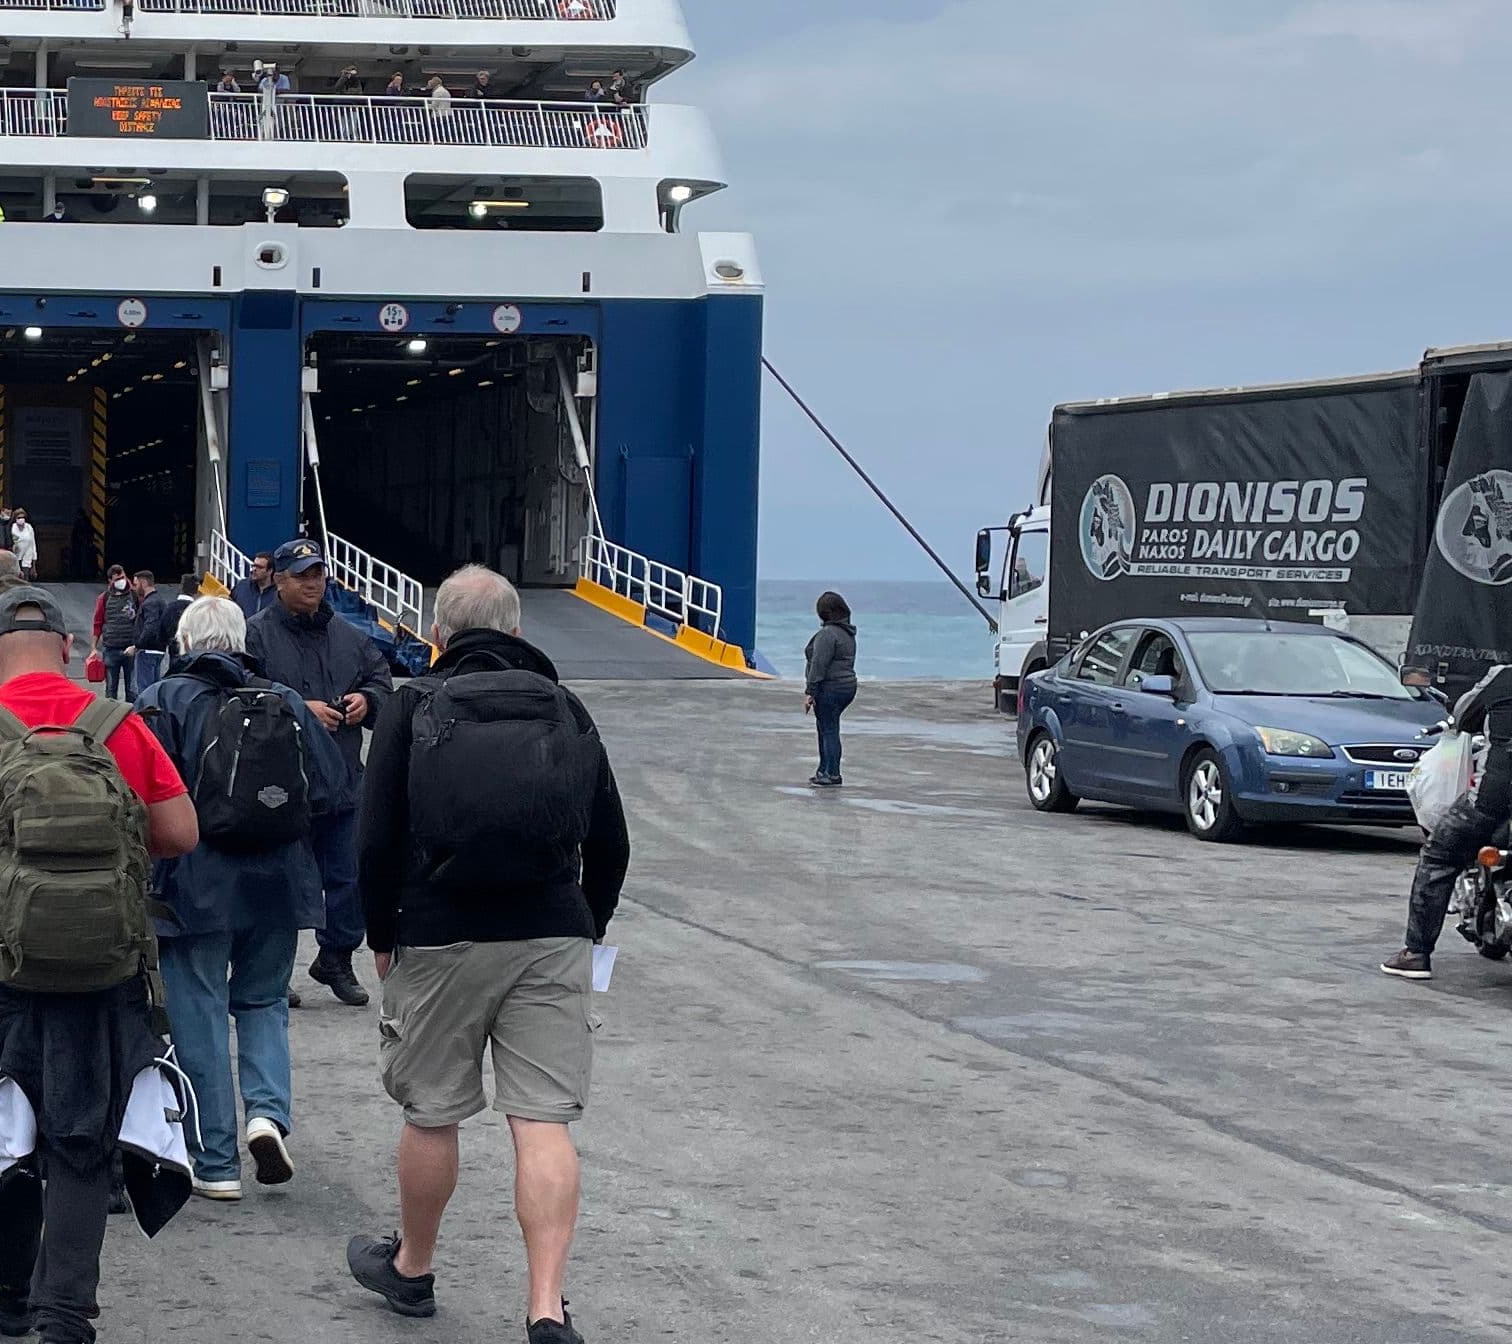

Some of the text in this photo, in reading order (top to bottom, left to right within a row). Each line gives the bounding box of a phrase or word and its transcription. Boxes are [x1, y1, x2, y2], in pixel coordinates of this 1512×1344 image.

[1143, 477, 1368, 524] DIONISOS
[1141, 528, 1188, 544] PAROS
[1139, 544, 1186, 560] NAXOS
[1191, 529, 1361, 562] DAILY CARGO
[1137, 564, 1343, 581] RELIABLE TRANSPORT SERVICES
